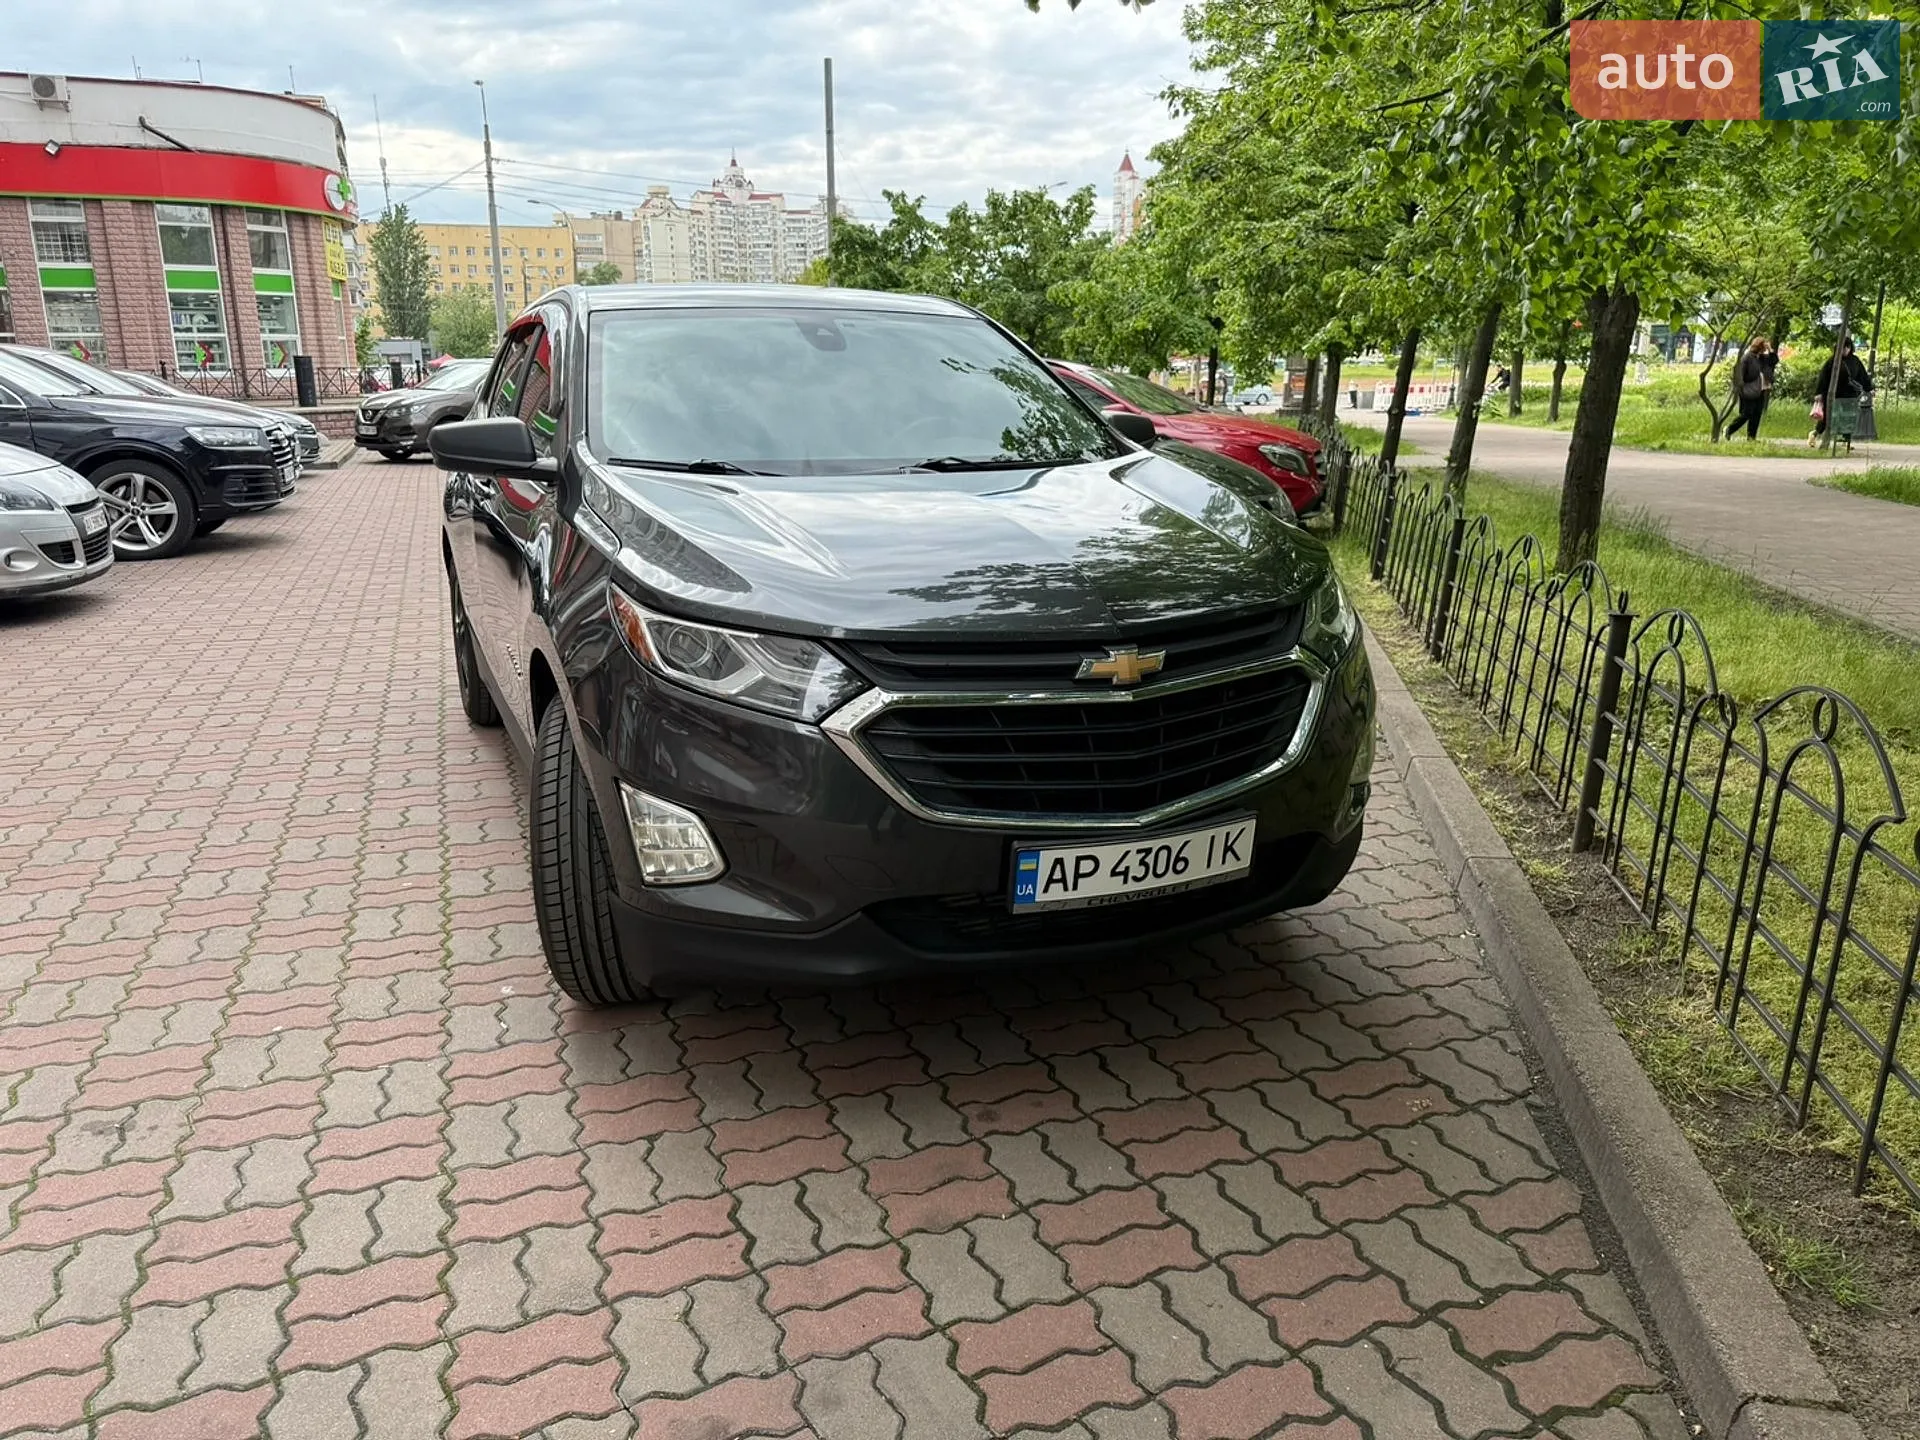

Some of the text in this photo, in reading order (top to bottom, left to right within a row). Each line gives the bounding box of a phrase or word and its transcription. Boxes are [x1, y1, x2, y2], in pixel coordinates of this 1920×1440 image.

[1042, 827, 1246, 894] AP 4306 IK
[1017, 884, 1034, 896] UA
